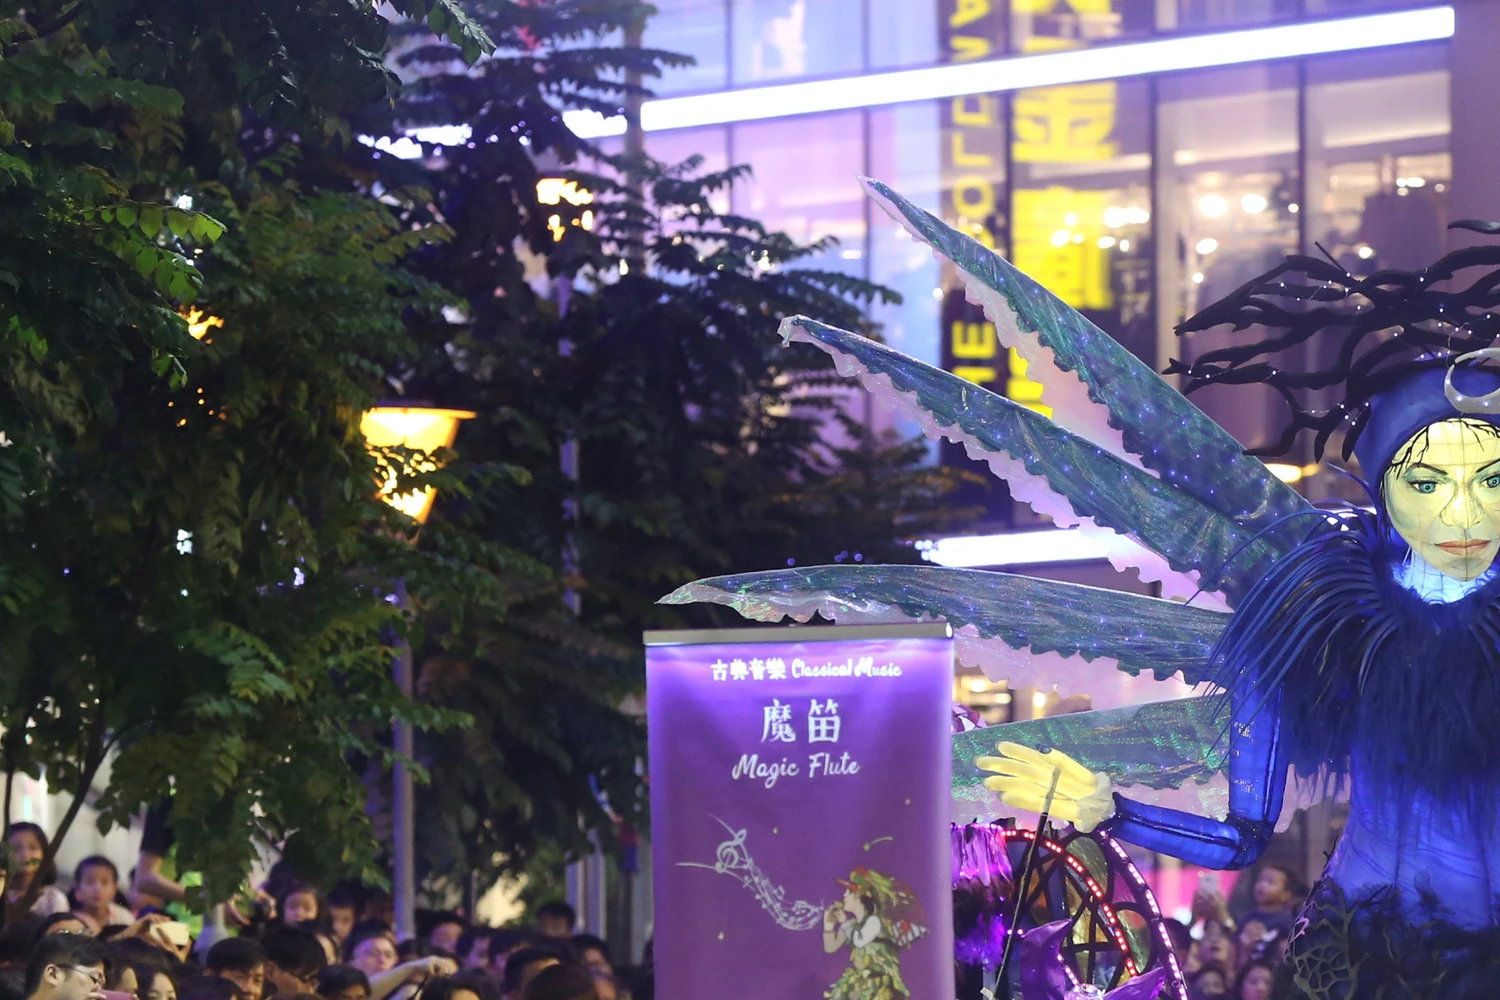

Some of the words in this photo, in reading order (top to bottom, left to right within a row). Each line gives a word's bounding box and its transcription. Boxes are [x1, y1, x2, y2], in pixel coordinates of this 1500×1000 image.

[710, 657, 787, 682] 古典音樂
[791, 657, 853, 679] Classical
[854, 656, 902, 678] Music
[760, 698, 841, 744] 魔笛
[731, 753, 800, 789] Magic
[808, 751, 860, 778] Flute
